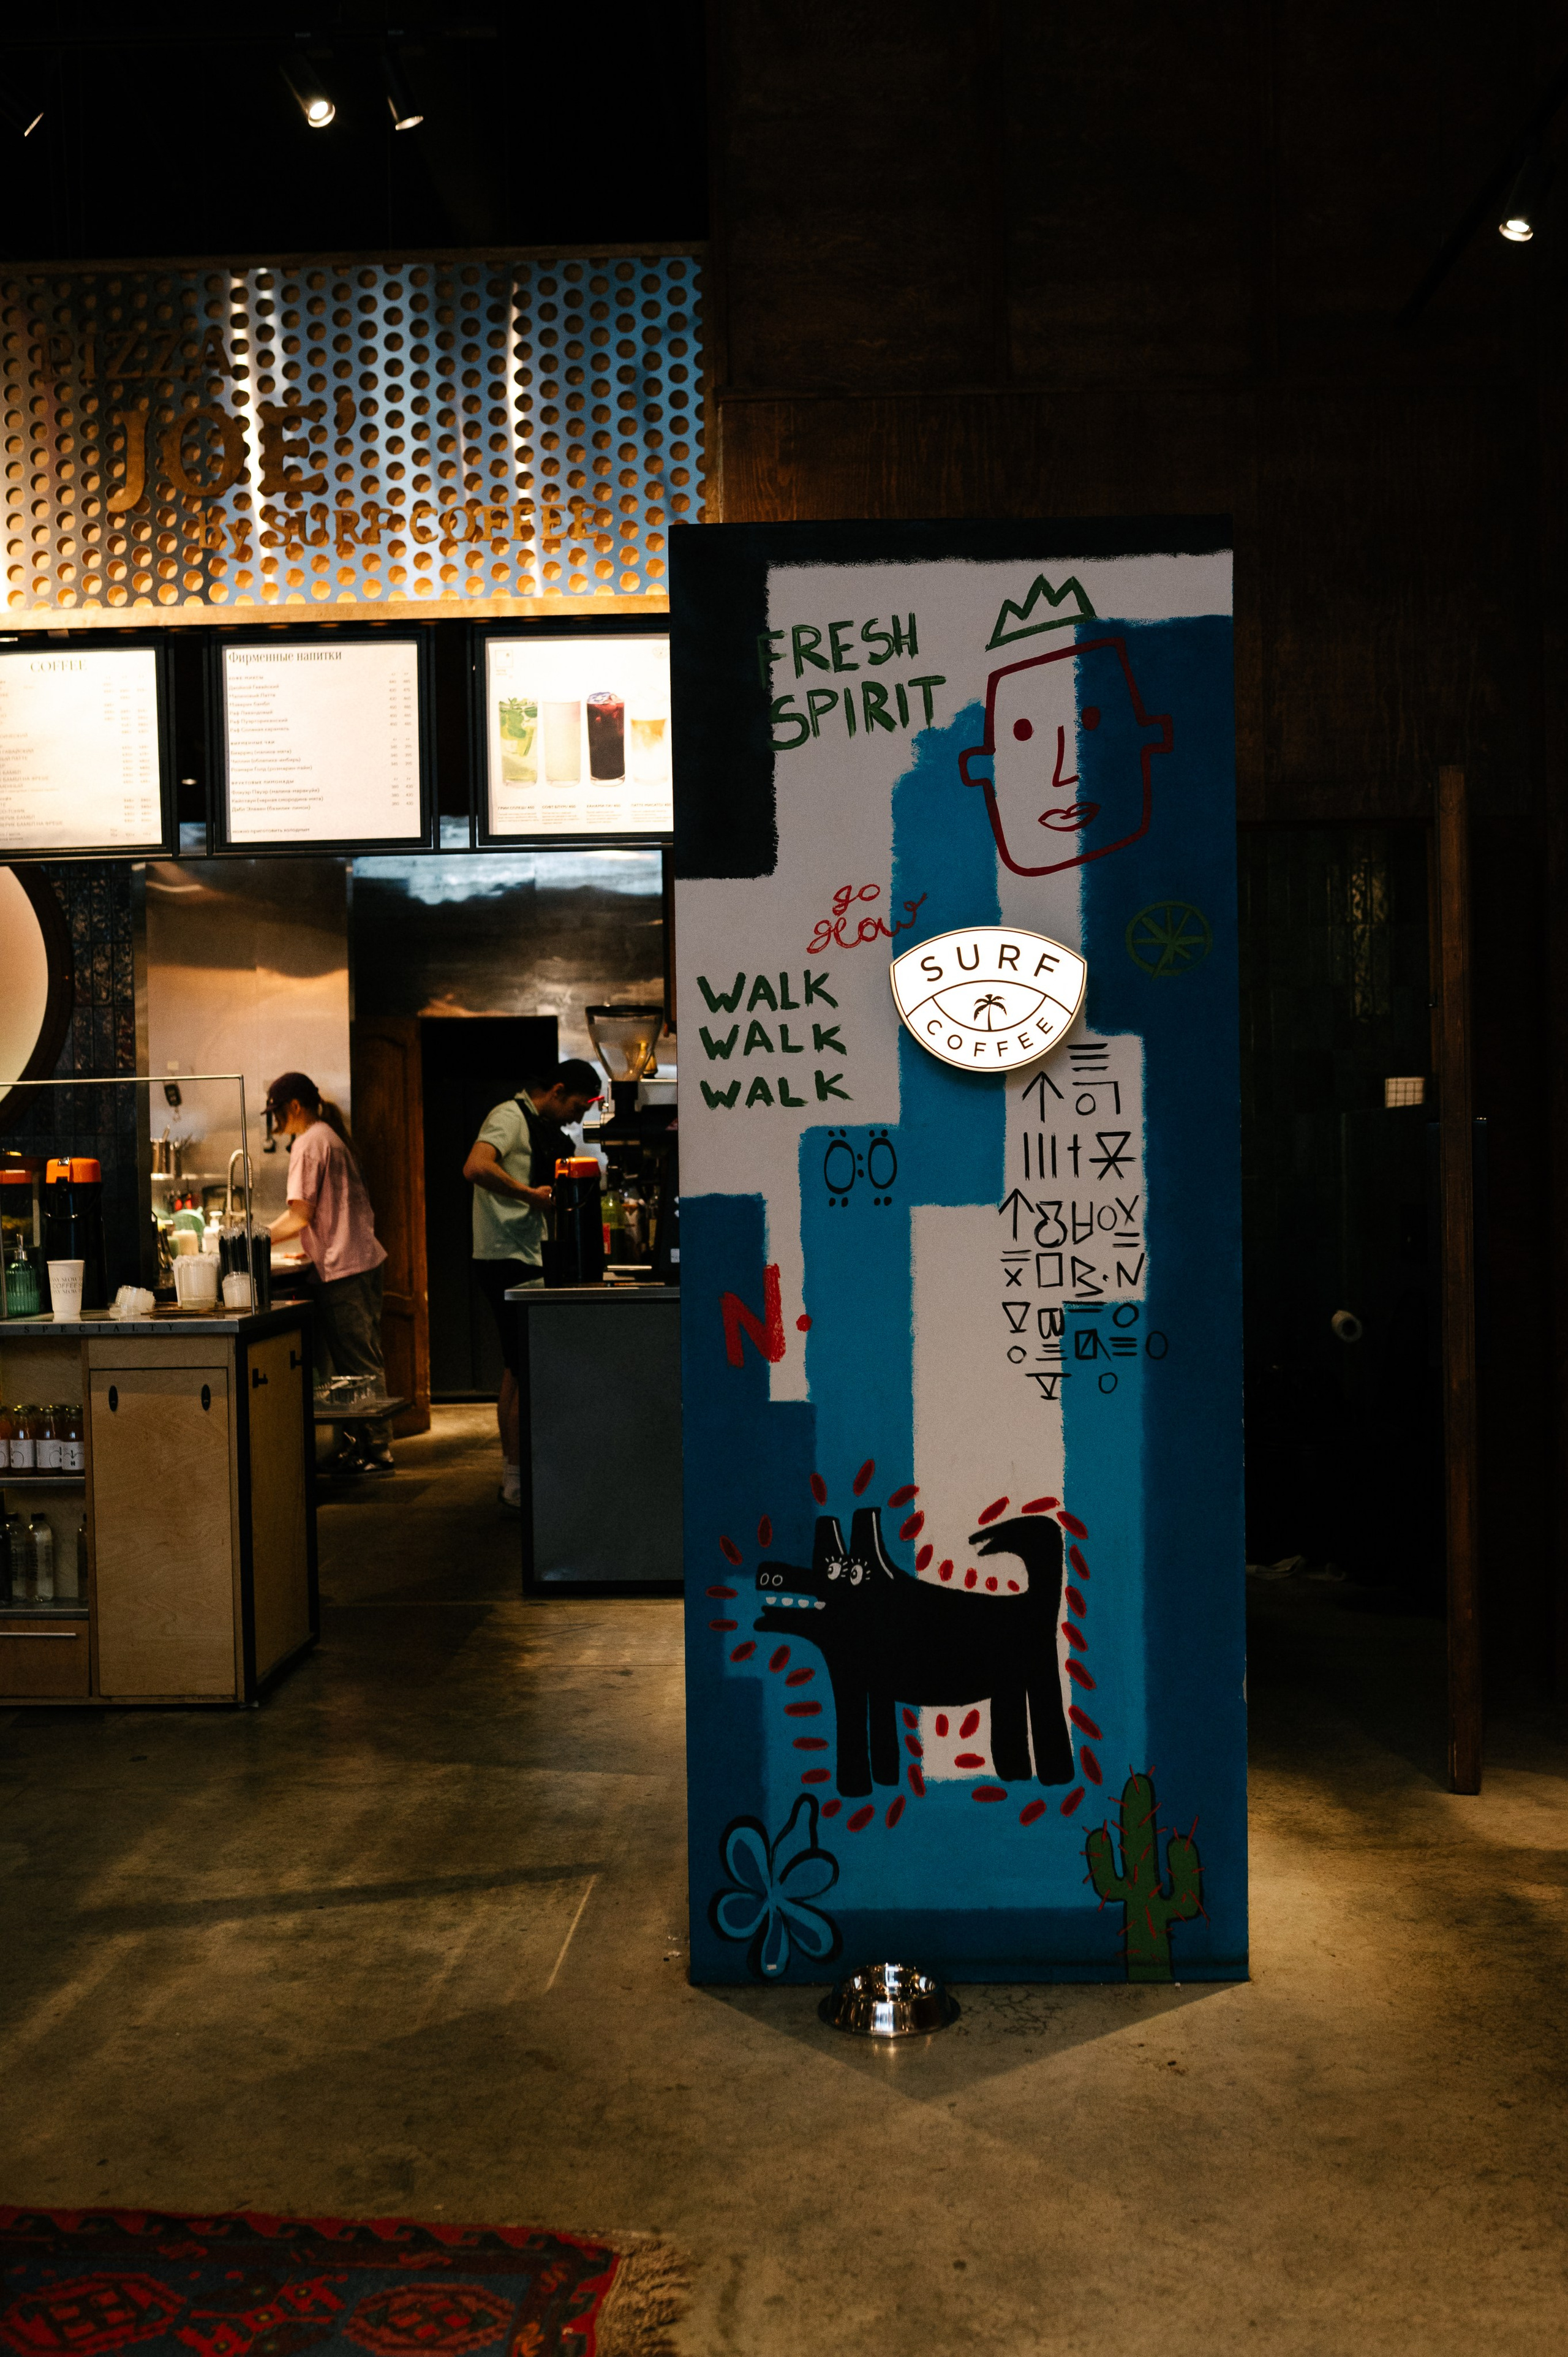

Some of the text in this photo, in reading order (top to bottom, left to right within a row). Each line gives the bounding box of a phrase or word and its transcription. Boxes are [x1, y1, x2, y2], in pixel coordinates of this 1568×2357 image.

[40, 326, 233, 382] PIZZA
[197, 502, 599, 559] by SURF COFFEE
[31, 660, 87, 672] COFFEE
[228, 651, 342, 666] Фирменные напитки
[756, 611, 920, 691] FRESH
[767, 674, 948, 752] SPIRIT
[832, 883, 881, 916] go
[920, 943, 1060, 982] SURF
[697, 969, 839, 1014] WALK
[698, 1020, 848, 1060] WALK
[926, 1016, 1054, 1058] COFFEE
[699, 1070, 854, 1109] WALK
[24, 1324, 174, 1333] SPECIALTY
